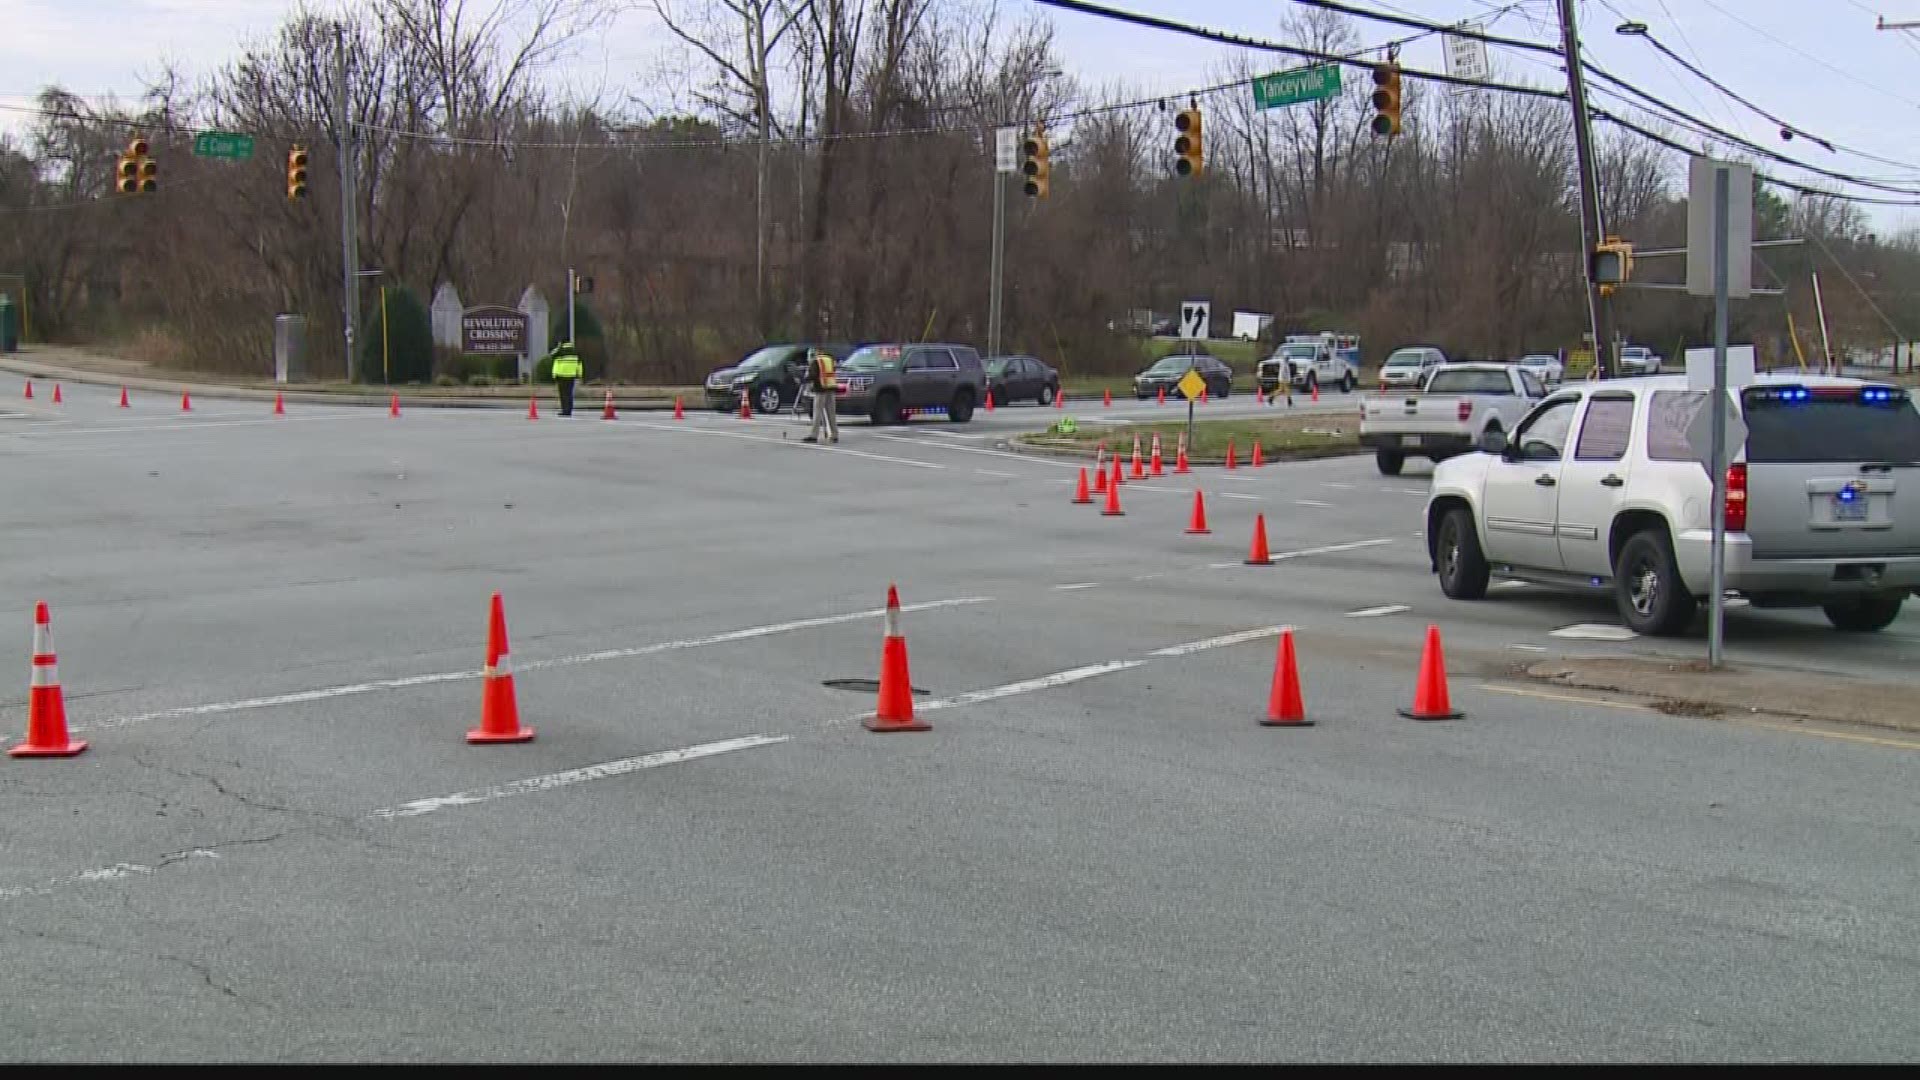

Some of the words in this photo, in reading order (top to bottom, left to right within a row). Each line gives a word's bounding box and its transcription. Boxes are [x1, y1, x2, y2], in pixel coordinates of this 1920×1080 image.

[1261, 72, 1324, 99] Yanceyville
[199, 137, 207, 151] E
[463, 318, 524, 329] REVOLUTION
[470, 329, 519, 340] CROSSING
